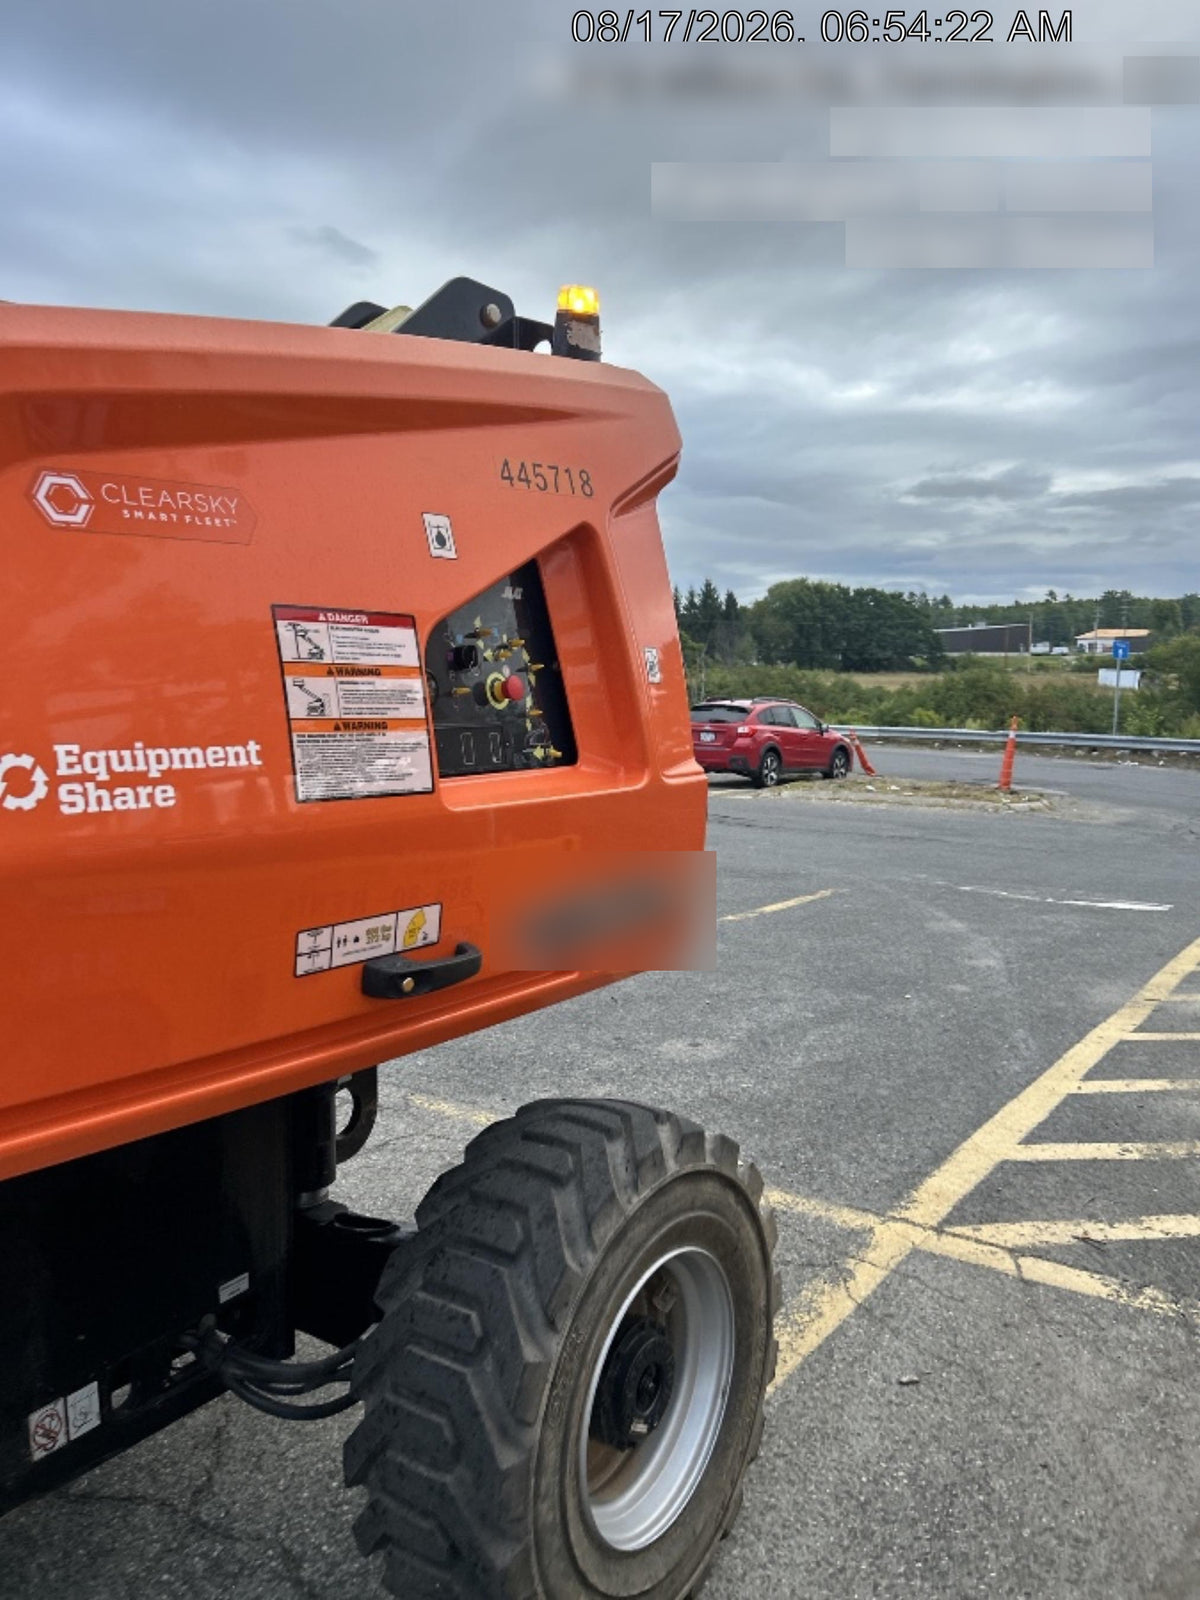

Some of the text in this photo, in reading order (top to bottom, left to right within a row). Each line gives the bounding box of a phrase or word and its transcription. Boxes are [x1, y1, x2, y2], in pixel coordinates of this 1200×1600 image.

[500, 458, 594, 497] 445718
[101, 482, 238, 515] CLEARSKY
[122, 509, 177, 522] SMART
[327, 613, 369, 624] DANGER
[336, 667, 382, 676] WARNING
[343, 722, 388, 731] WARNING
[53, 740, 263, 781] Equipment
[57, 782, 177, 815] Share
